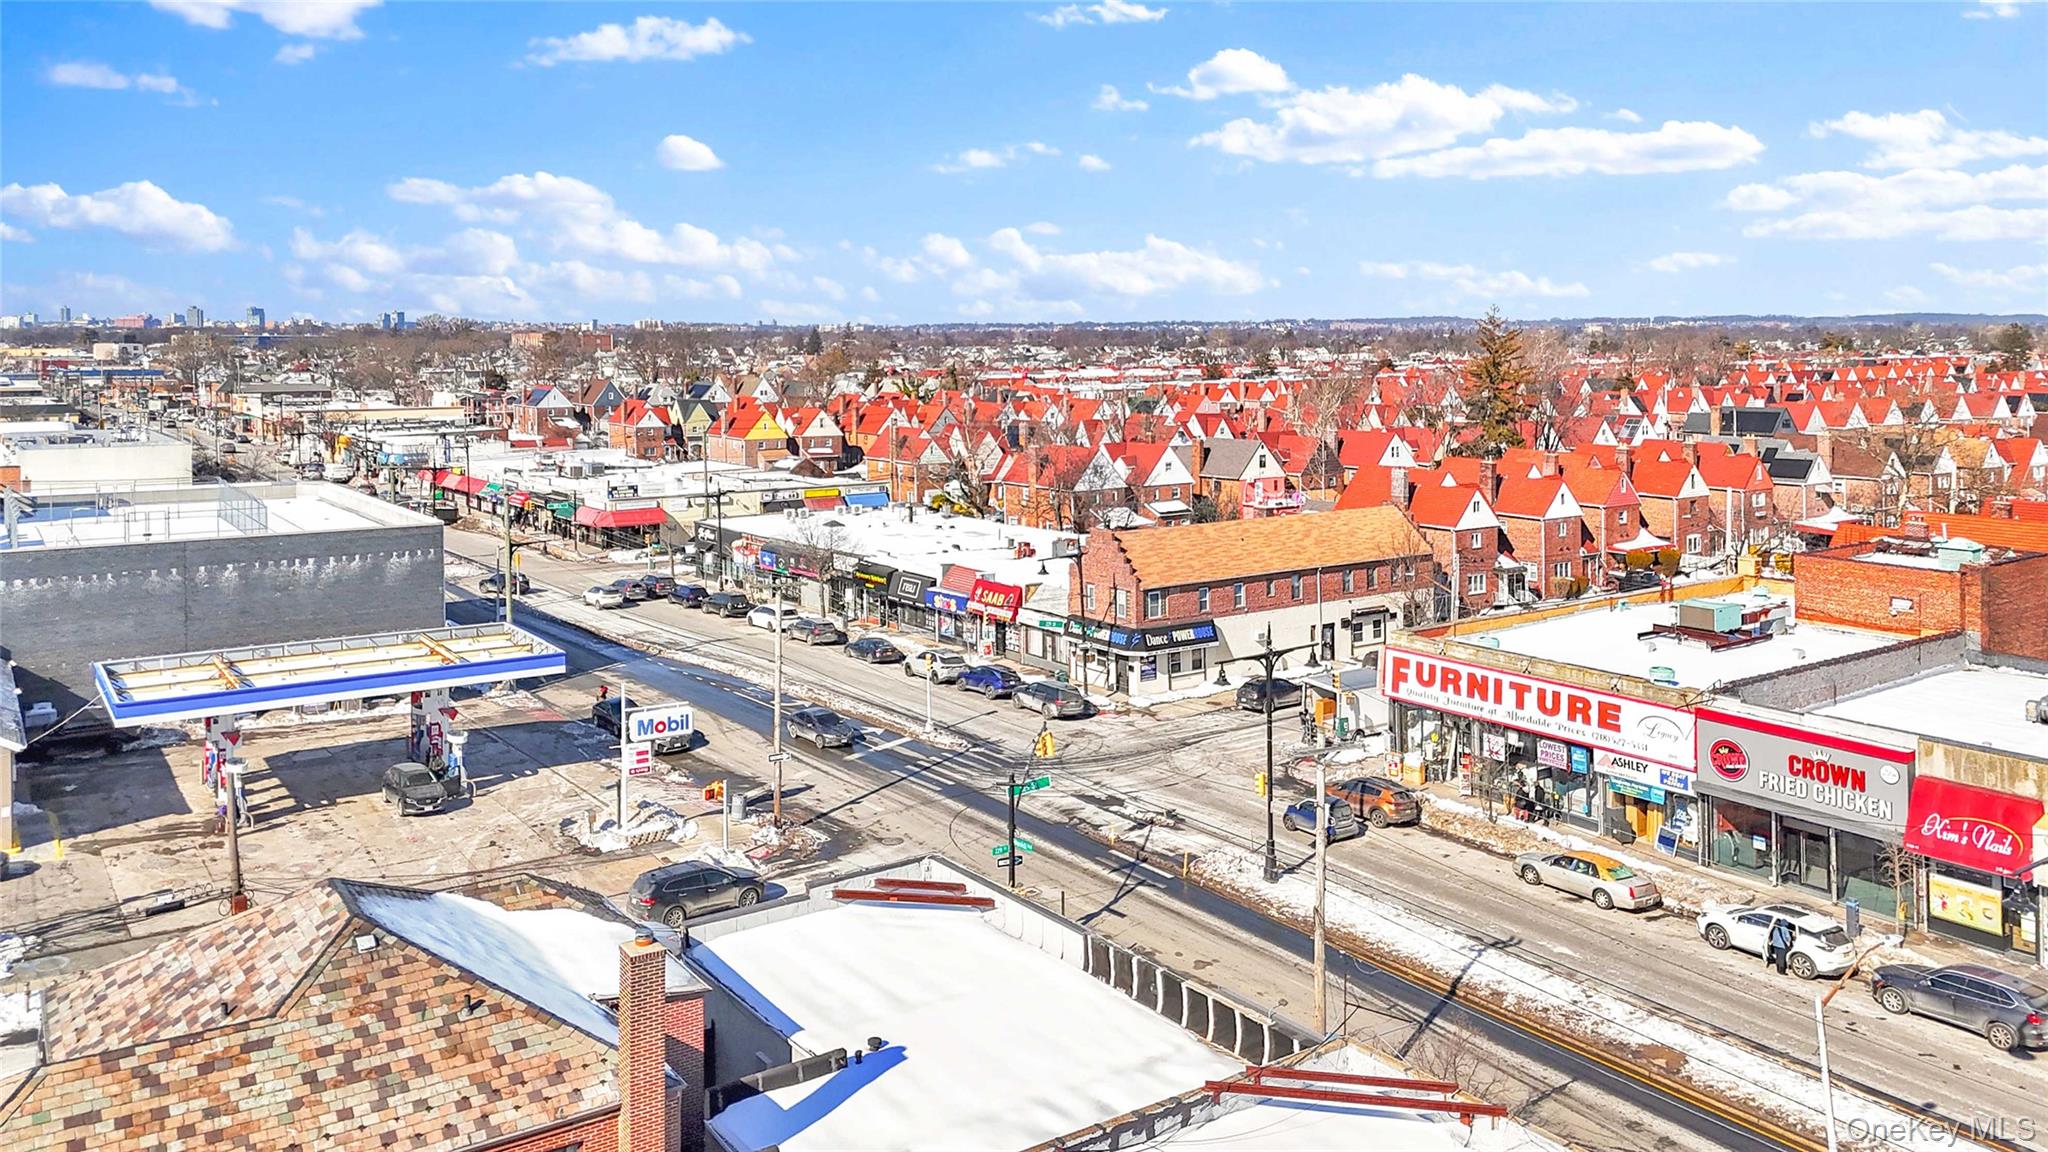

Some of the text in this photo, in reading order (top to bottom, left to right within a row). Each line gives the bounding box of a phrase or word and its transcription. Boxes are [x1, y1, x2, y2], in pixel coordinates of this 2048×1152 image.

[981, 590, 1005, 606] SAAB
[1145, 633, 1169, 647] Dance
[1391, 655, 1622, 733] FURNITURE
[1406, 687, 1439, 703] Quality
[1442, 695, 1485, 712] Furniture
[1504, 710, 1552, 728] Affordable
[1555, 721, 1586, 737] Prices
[637, 713, 690, 736] Mobil
[1643, 721, 1679, 743] Legacy
[1539, 741, 1565, 754] LOWEST
[1540, 749, 1565, 762] PRICES
[1611, 756, 1648, 773] ASHLEY
[1787, 754, 1866, 793] CROWN
[1759, 770, 1893, 821] FRIED CHICKEN
[1921, 813, 2013, 856] Kim's Nails
